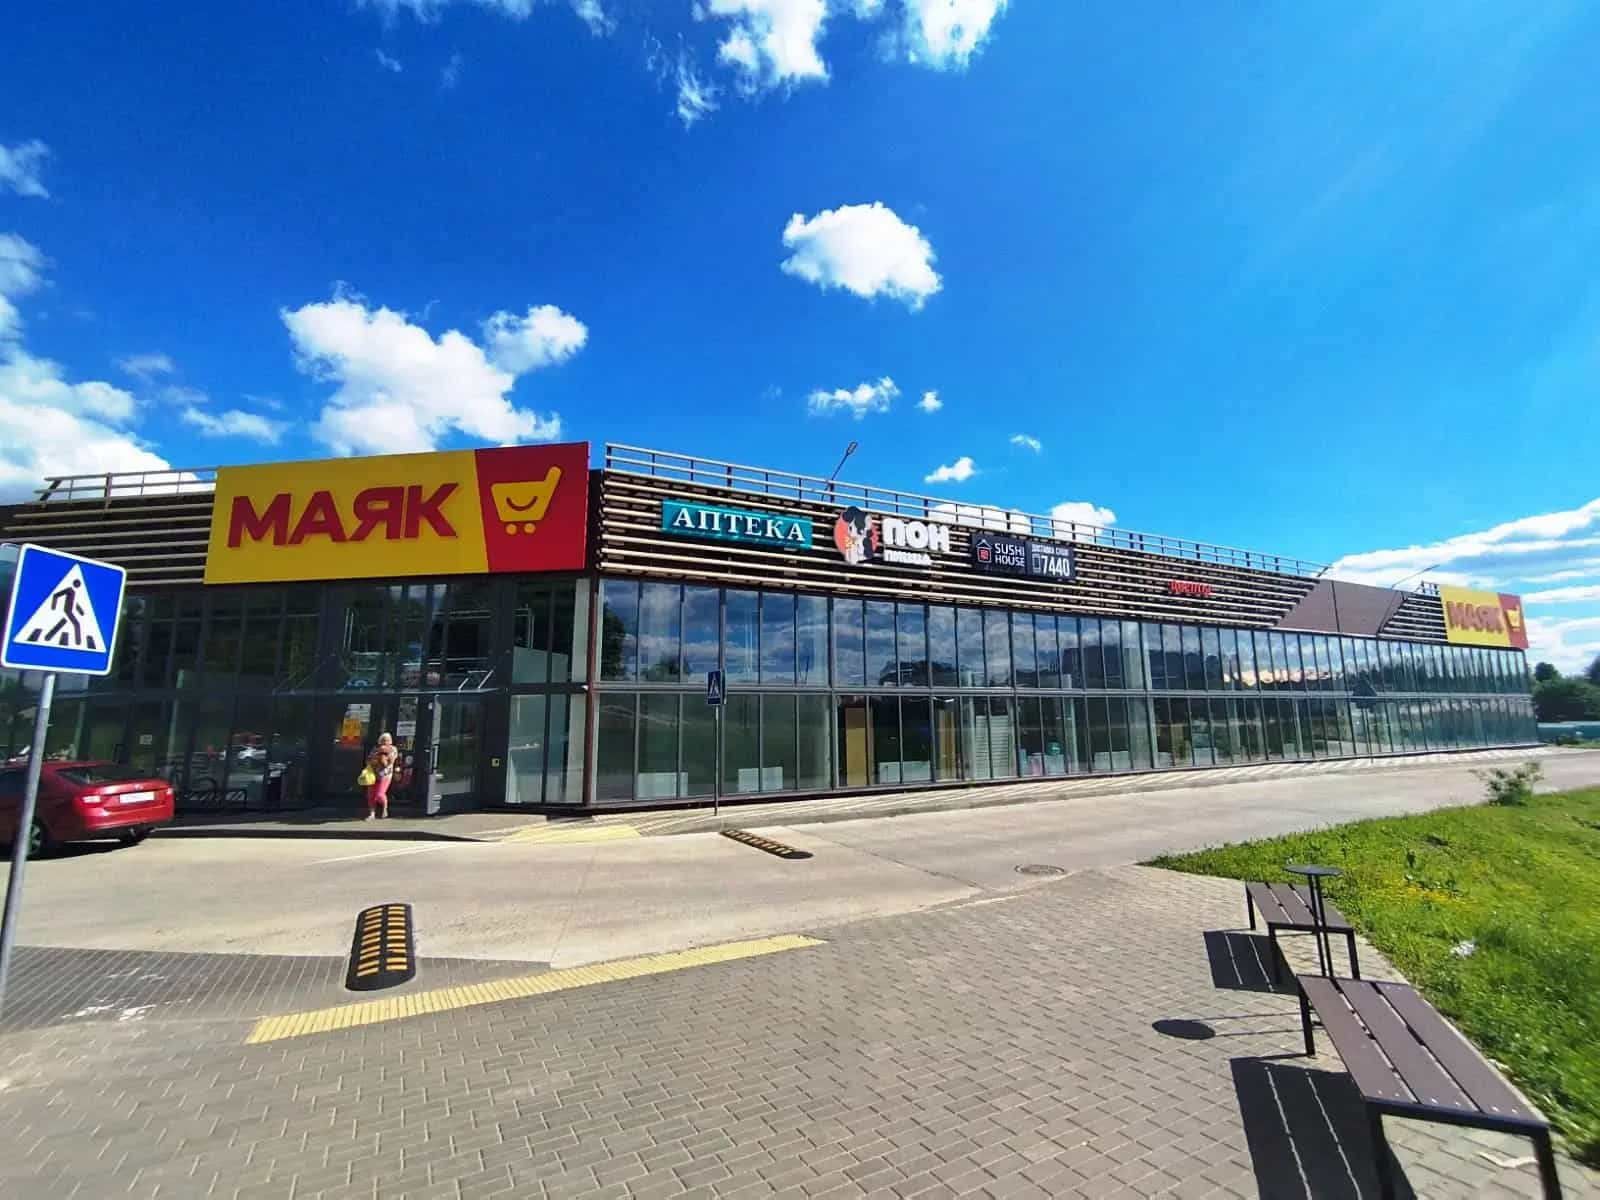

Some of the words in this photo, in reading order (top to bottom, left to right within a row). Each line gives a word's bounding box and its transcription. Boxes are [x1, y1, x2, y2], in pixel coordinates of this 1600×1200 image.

[228, 483, 459, 548] МАЯК
[673, 507, 806, 542] АПТЕКА
[882, 519, 950, 552] ПОН
[994, 543, 1025, 557] SUSHI
[994, 554, 1025, 567] HOUSE
[1041, 555, 1070, 577] 7440
[1447, 601, 1503, 634] МАЯК
